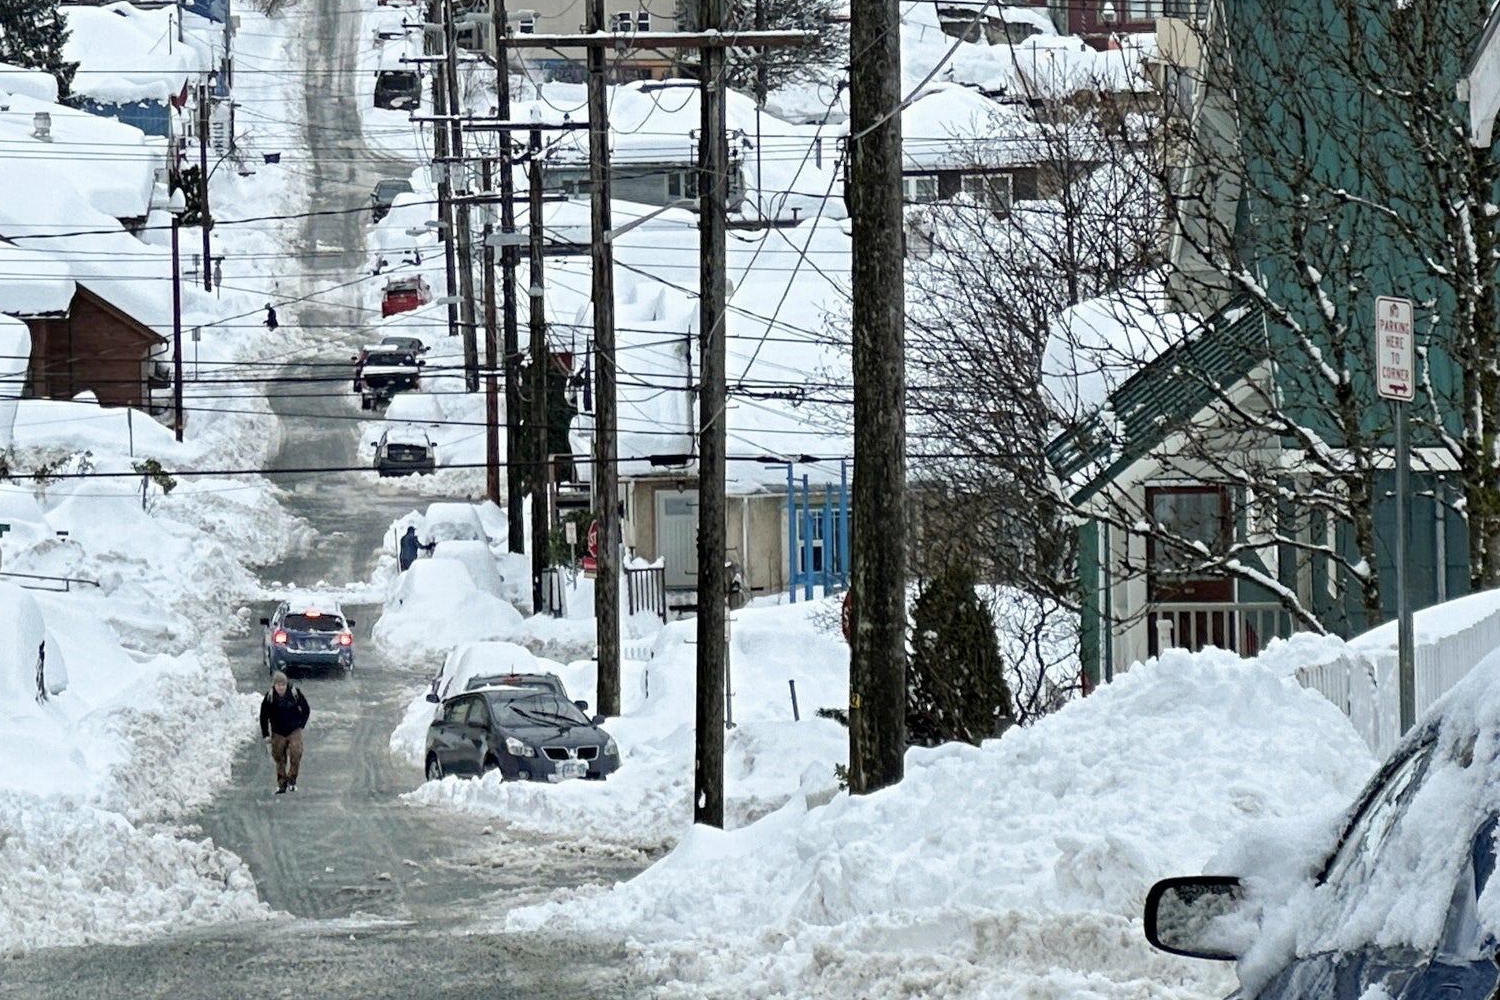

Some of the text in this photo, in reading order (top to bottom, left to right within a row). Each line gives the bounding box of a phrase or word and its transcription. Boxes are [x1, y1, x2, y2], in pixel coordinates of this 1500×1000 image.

[1380, 319, 1410, 335] PARKING
[1386, 335, 1405, 351] HERE
[1391, 351, 1400, 366] TO
[1382, 367, 1409, 382] CORNER
